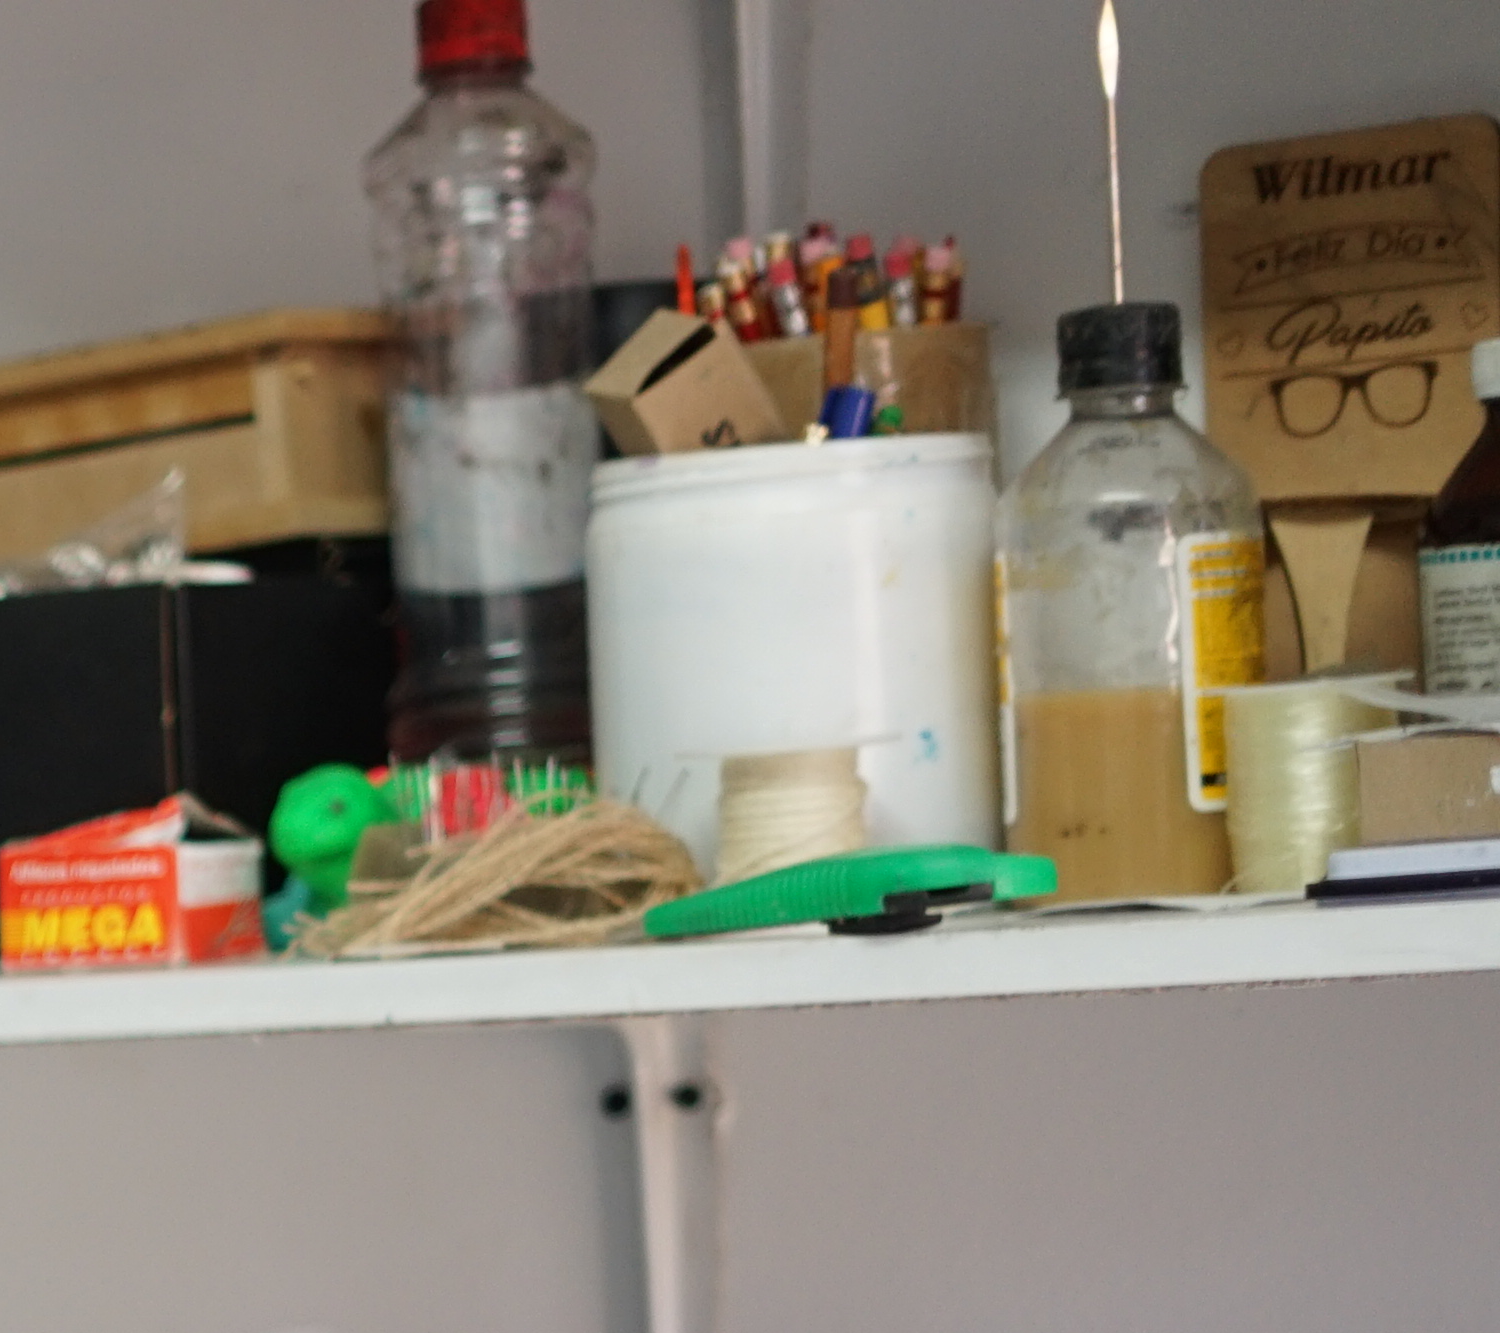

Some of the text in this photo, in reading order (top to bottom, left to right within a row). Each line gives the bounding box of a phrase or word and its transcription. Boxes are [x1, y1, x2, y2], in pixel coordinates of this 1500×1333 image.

[1253, 152, 1452, 203] Wilmar
[1265, 297, 1433, 367] Papito
[21, 903, 165, 950] MEGA
